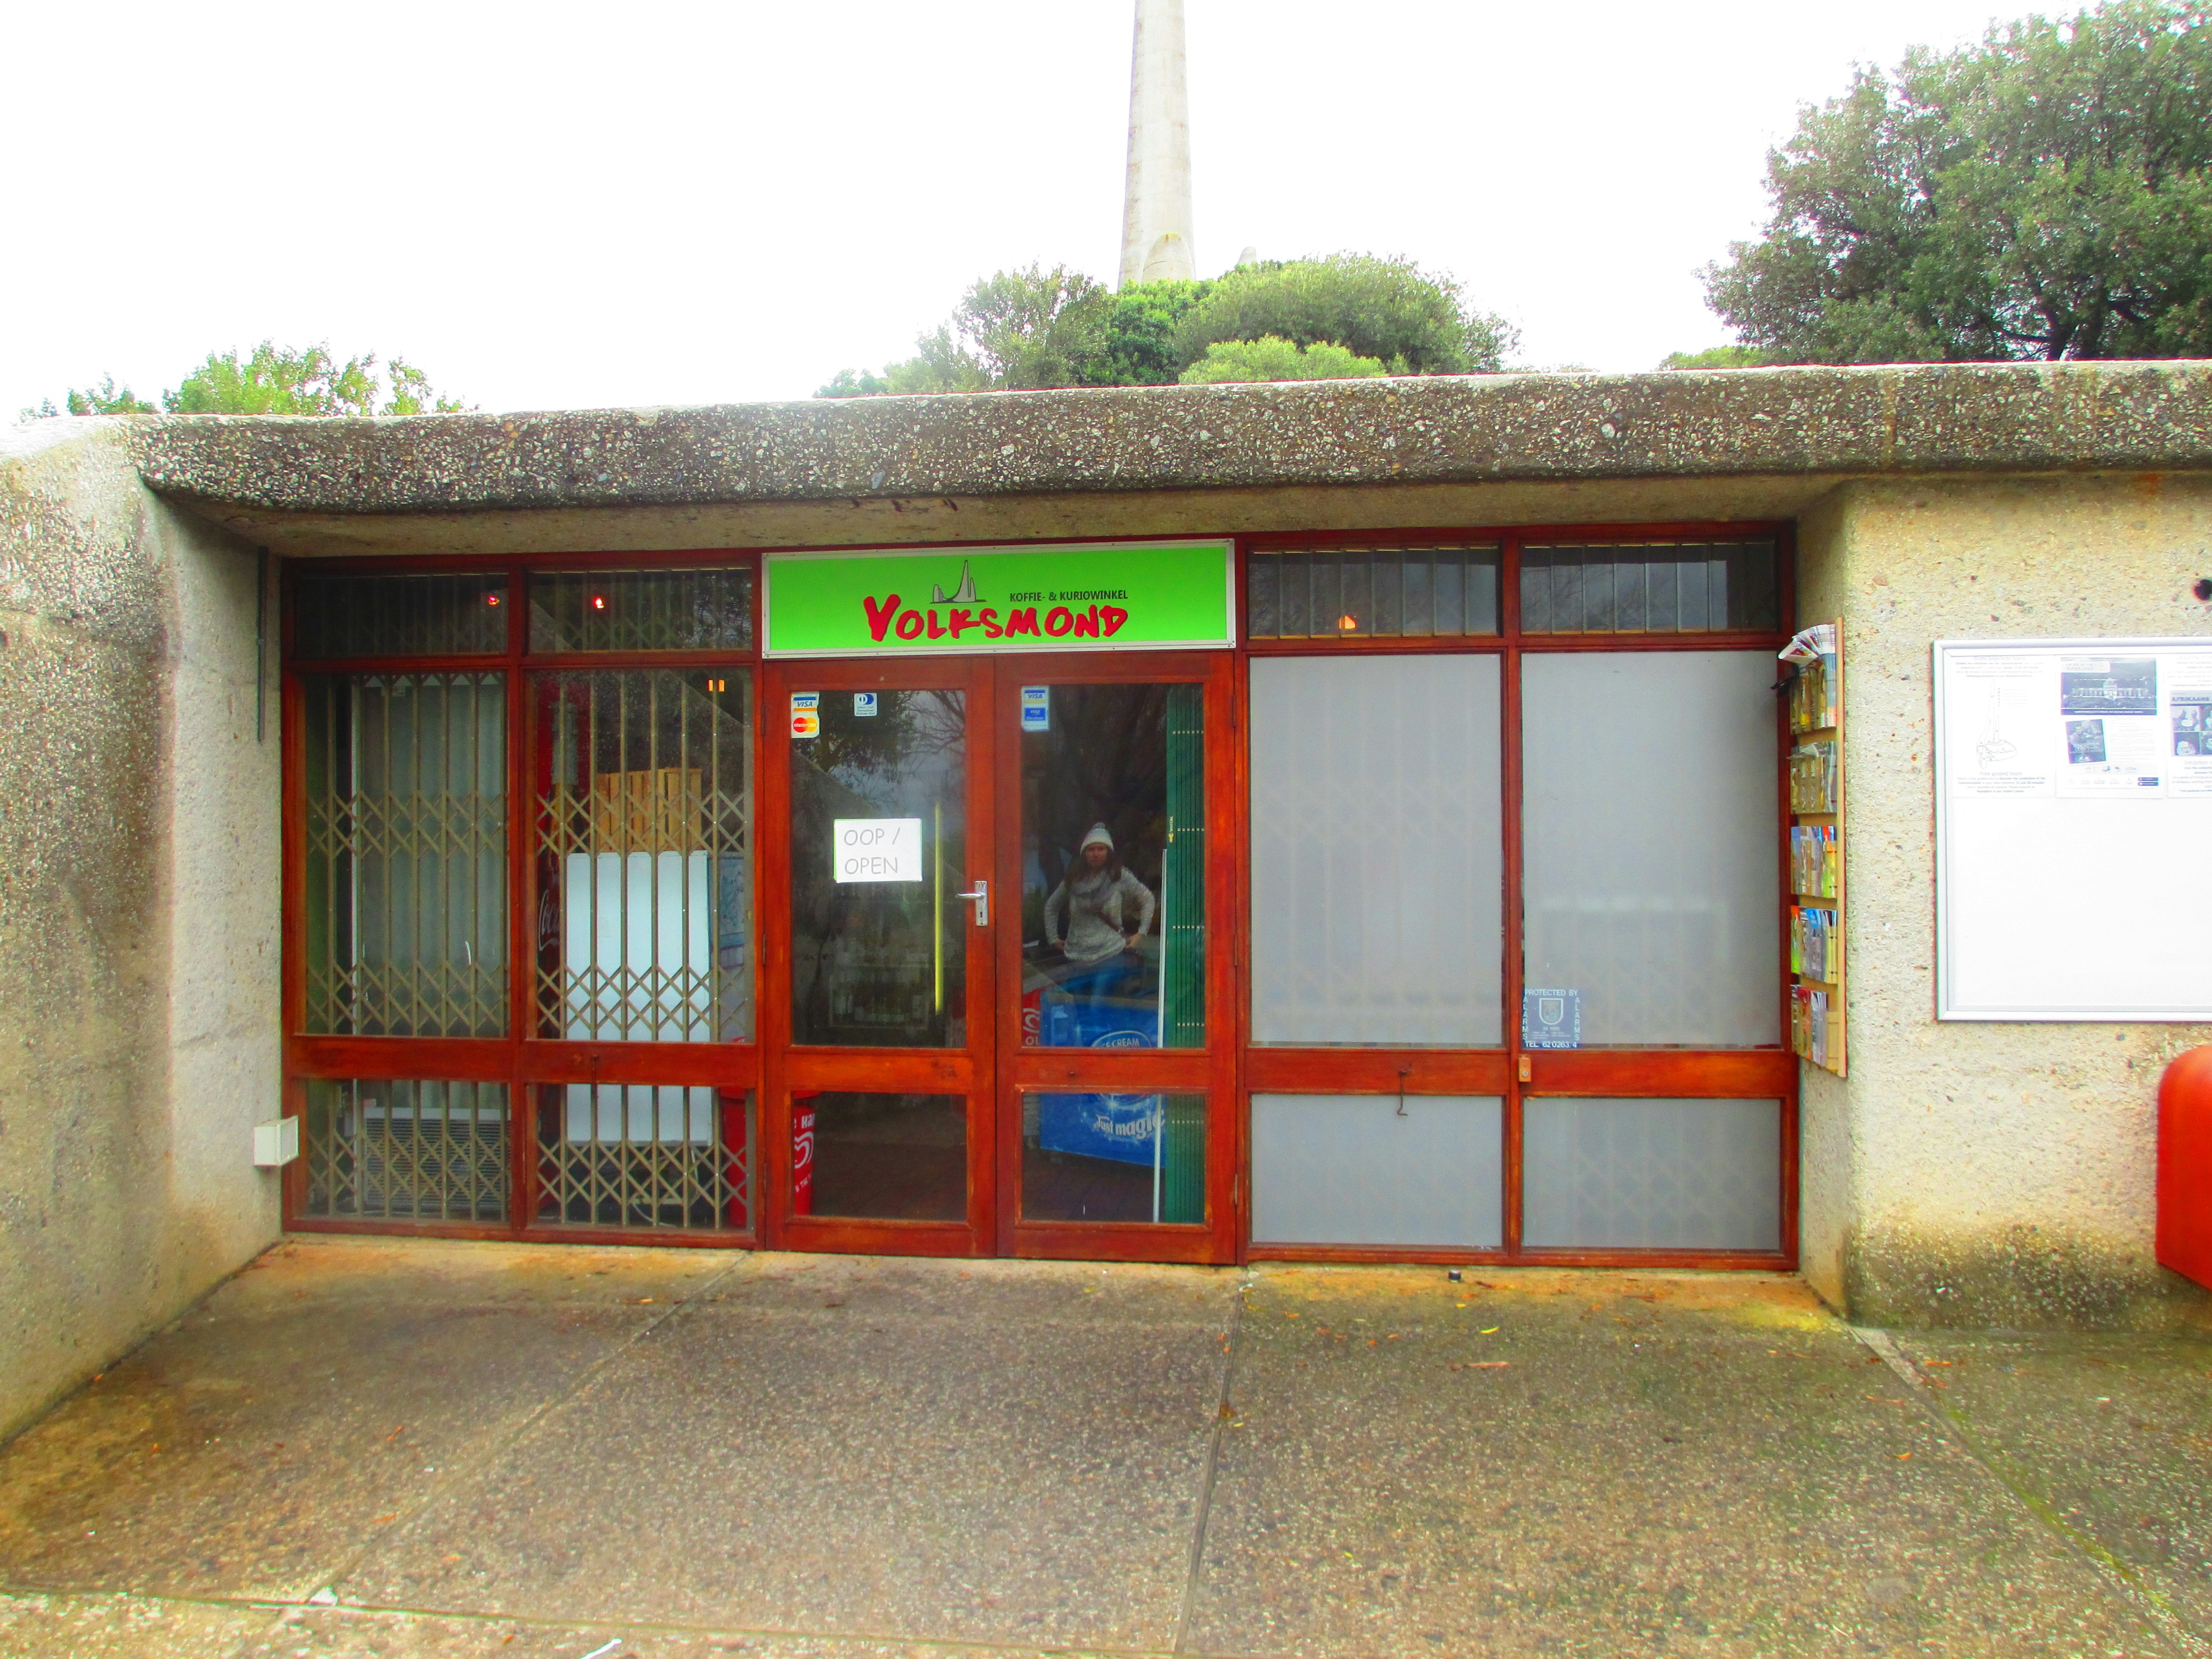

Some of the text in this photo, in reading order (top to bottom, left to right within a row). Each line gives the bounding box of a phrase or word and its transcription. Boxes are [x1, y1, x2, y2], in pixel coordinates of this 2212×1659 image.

[1010, 589, 1129, 602] KOFFIE- & KURIOWINKEL
[863, 594, 1128, 642] VOLKSMOND
[844, 827, 901, 846] OOP /
[845, 857, 898, 875] OPEN
